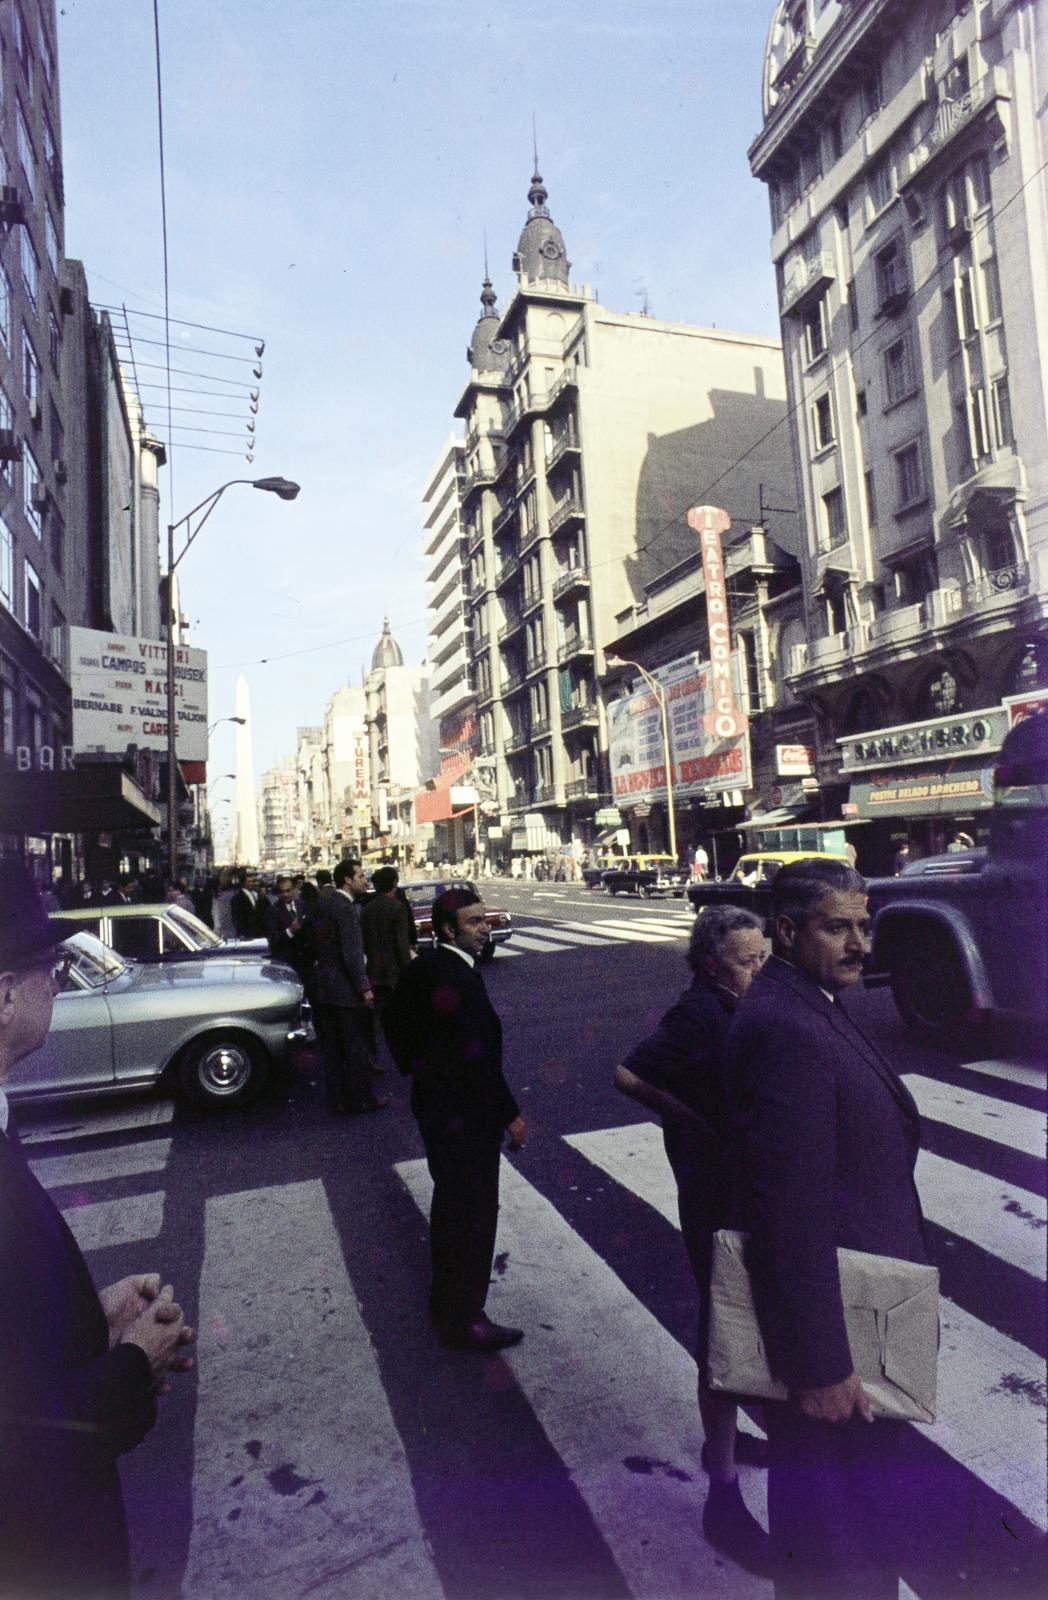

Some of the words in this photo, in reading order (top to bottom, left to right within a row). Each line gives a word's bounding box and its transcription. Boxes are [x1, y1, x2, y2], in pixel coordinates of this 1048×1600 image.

[702, 509, 724, 614] TEATRO
[101, 654, 146, 675] CAMPOS
[139, 643, 189, 664] VITTRI
[708, 622, 737, 738] COMICO
[142, 721, 180, 737] CARRE
[17, 745, 76, 771] BAR
